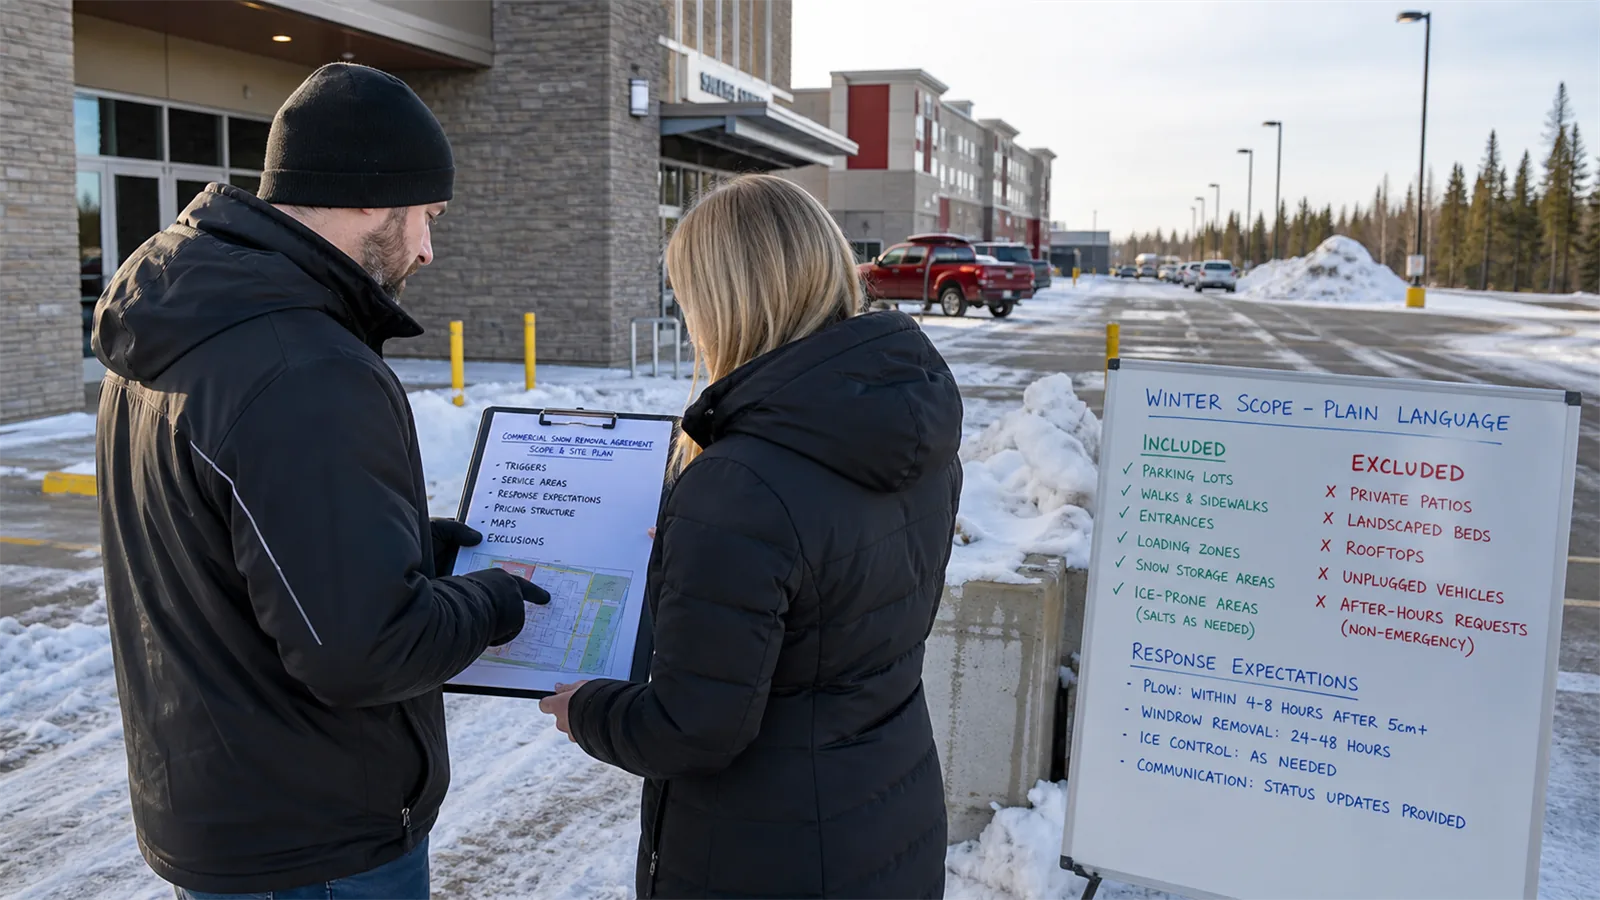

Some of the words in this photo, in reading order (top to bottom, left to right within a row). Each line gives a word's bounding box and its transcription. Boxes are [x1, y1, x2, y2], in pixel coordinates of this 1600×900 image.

[1146, 388, 1222, 411] WINTER
[1237, 394, 1293, 416] SCOPE
[1325, 400, 1378, 421] PLAIN
[1398, 406, 1511, 432] LANGUAGE
[502, 432, 547, 442] COMMERCIAL
[551, 435, 572, 443] SNOW
[575, 437, 607, 446] REMOVAL
[610, 439, 654, 448] AGREEMENT
[529, 445, 554, 454] SCOPE
[569, 448, 587, 456] SITE
[592, 449, 614, 457] PLAN
[1143, 434, 1226, 458] INCLUDED
[505, 461, 547, 472] TRIGGERS
[1143, 464, 1195, 483] PARKING
[1203, 472, 1234, 486] LOTS
[1352, 454, 1465, 482] EXCLUDED
[501, 476, 535, 486] SERVICE
[539, 478, 567, 488] AREAS
[498, 489, 539, 500] RESPONSE
[543, 492, 602, 504] EXPECTATIONS
[1141, 488, 1180, 503] WALKS
[1186, 493, 1194, 505] &
[1200, 495, 1269, 513] SIDEWALKS
[1351, 487, 1409, 506] PRIVATE
[1421, 494, 1473, 513] PATIOS
[494, 503, 526, 514] PRICING
[531, 506, 575, 517] STRUCTURE
[1140, 509, 1215, 530] ENTRANCES
[490, 519, 517, 528] MAPS
[1348, 513, 1443, 537] LANDSCAPED
[1454, 526, 1491, 543] BEDS
[487, 532, 545, 546] EXCLUSIONS
[1138, 535, 1190, 554] LOADING
[1199, 543, 1241, 560] ZONES
[1347, 541, 1425, 564] ROOFTOPS
[1136, 558, 1170, 573] SNOW
[1177, 565, 1228, 582] STORAGE
[1236, 573, 1276, 589] AREAS
[1343, 570, 1428, 594] UNPLUGGED
[1437, 583, 1505, 604] VEHICLES
[1135, 586, 1207, 608] ICE-PRONE
[1216, 597, 1259, 615] AREAS
[1136, 606, 1177, 624] (SALTS
[1183, 614, 1198, 627] AS
[1204, 619, 1256, 640] NEEDED)
[1340, 597, 1444, 625] AFTER-HOURS
[1455, 614, 1528, 637] REQUESTS
[1341, 619, 1475, 657] (NON-EMERGENCY)
[1132, 642, 1217, 671] RESPONSE
[1232, 658, 1359, 692] EXPECTATIONS
[1143, 679, 1182, 696] PLOW:
[1191, 688, 1237, 706] WITHIN
[1246, 696, 1273, 713] 4-8
[1281, 702, 1324, 721] HOURS
[1333, 710, 1379, 729] AFTER
[1388, 718, 1428, 736] 5cm+
[1141, 705, 1203, 726] WINDROW
[1213, 717, 1280, 740] REMOVAL:
[1291, 730, 1338, 750] 24-48
[1347, 739, 1391, 758] HOURS
[1140, 731, 1161, 746] ICE
[1170, 736, 1239, 759] CONTROL:
[1250, 750, 1268, 765] AS
[1279, 756, 1338, 777] NEEDED
[1137, 758, 1254, 789] COMMUNICATION:
[1264, 779, 1316, 801] STATUS
[1327, 792, 1391, 814] UPDATES
[1402, 804, 1467, 830] PROVIDED
